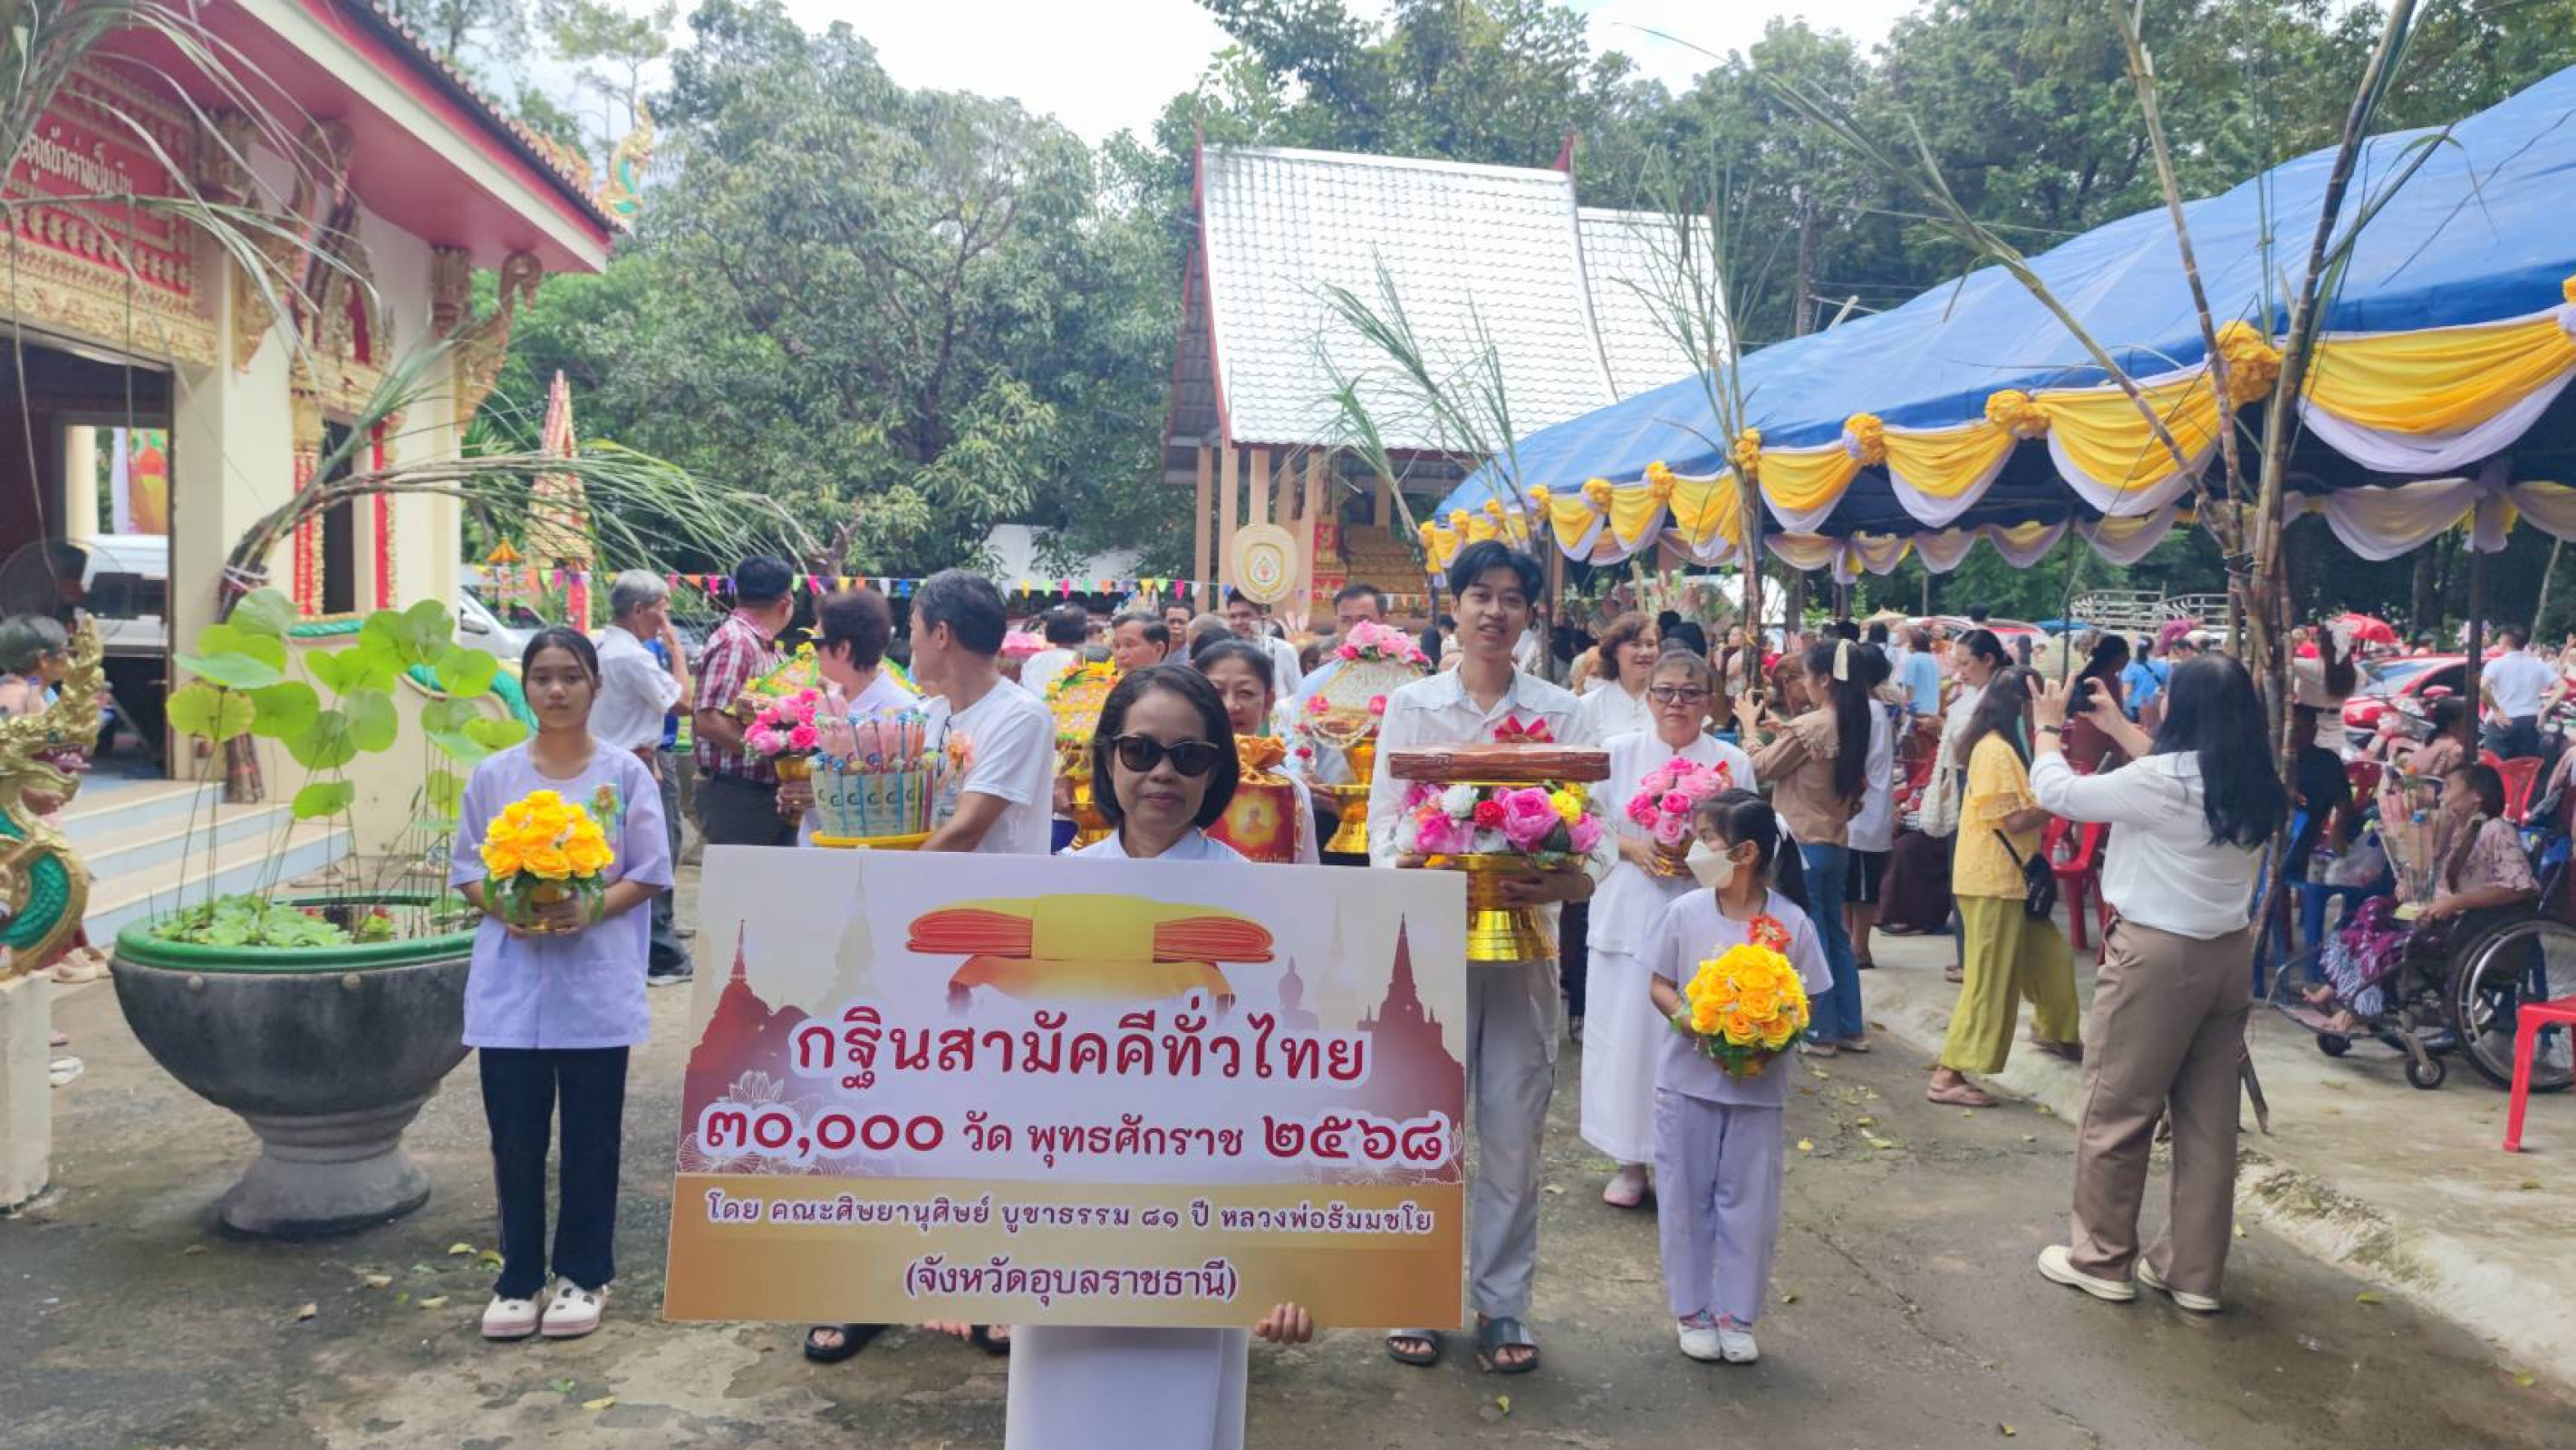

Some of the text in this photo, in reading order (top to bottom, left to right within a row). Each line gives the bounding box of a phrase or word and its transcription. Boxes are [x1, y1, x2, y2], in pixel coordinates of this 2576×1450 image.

[797, 995, 1364, 1090] กฐินสามัคคีทั่วไทย
[706, 1109, 1442, 1169] ๓๐,๐๐๐ วัด พุทธศักราช ๒๕๖๘
[708, 1191, 1433, 1233] โดย คณะศิษยานุศิษย์ บูชาธรรม ๘๑ ปี หลวงพ่อธัมมชโย
[905, 1255, 1237, 1308] (จังหวัดอุบลราชธานี)
